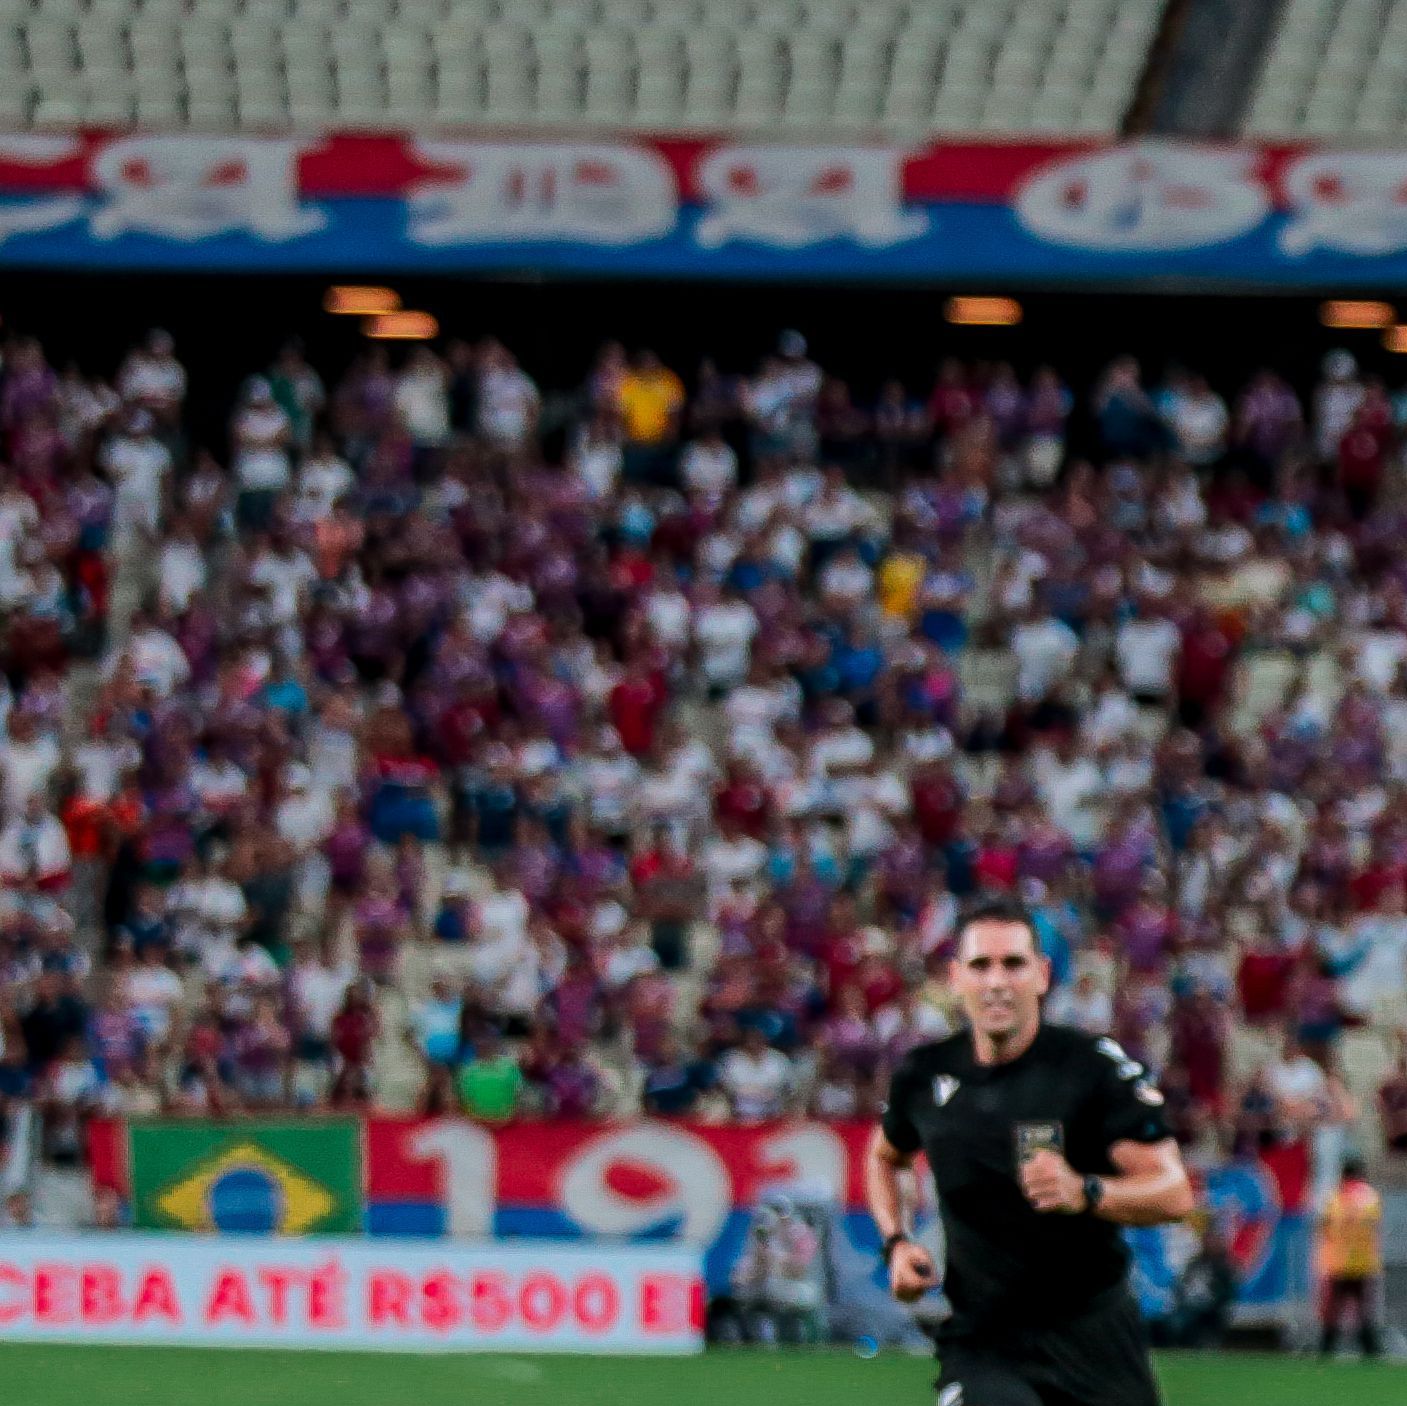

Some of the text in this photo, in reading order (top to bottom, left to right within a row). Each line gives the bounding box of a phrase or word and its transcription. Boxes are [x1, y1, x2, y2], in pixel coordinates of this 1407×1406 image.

[203, 1250, 347, 1329] ATÉ
[366, 1266, 620, 1337] R$500
[638, 1270, 707, 1333] E
